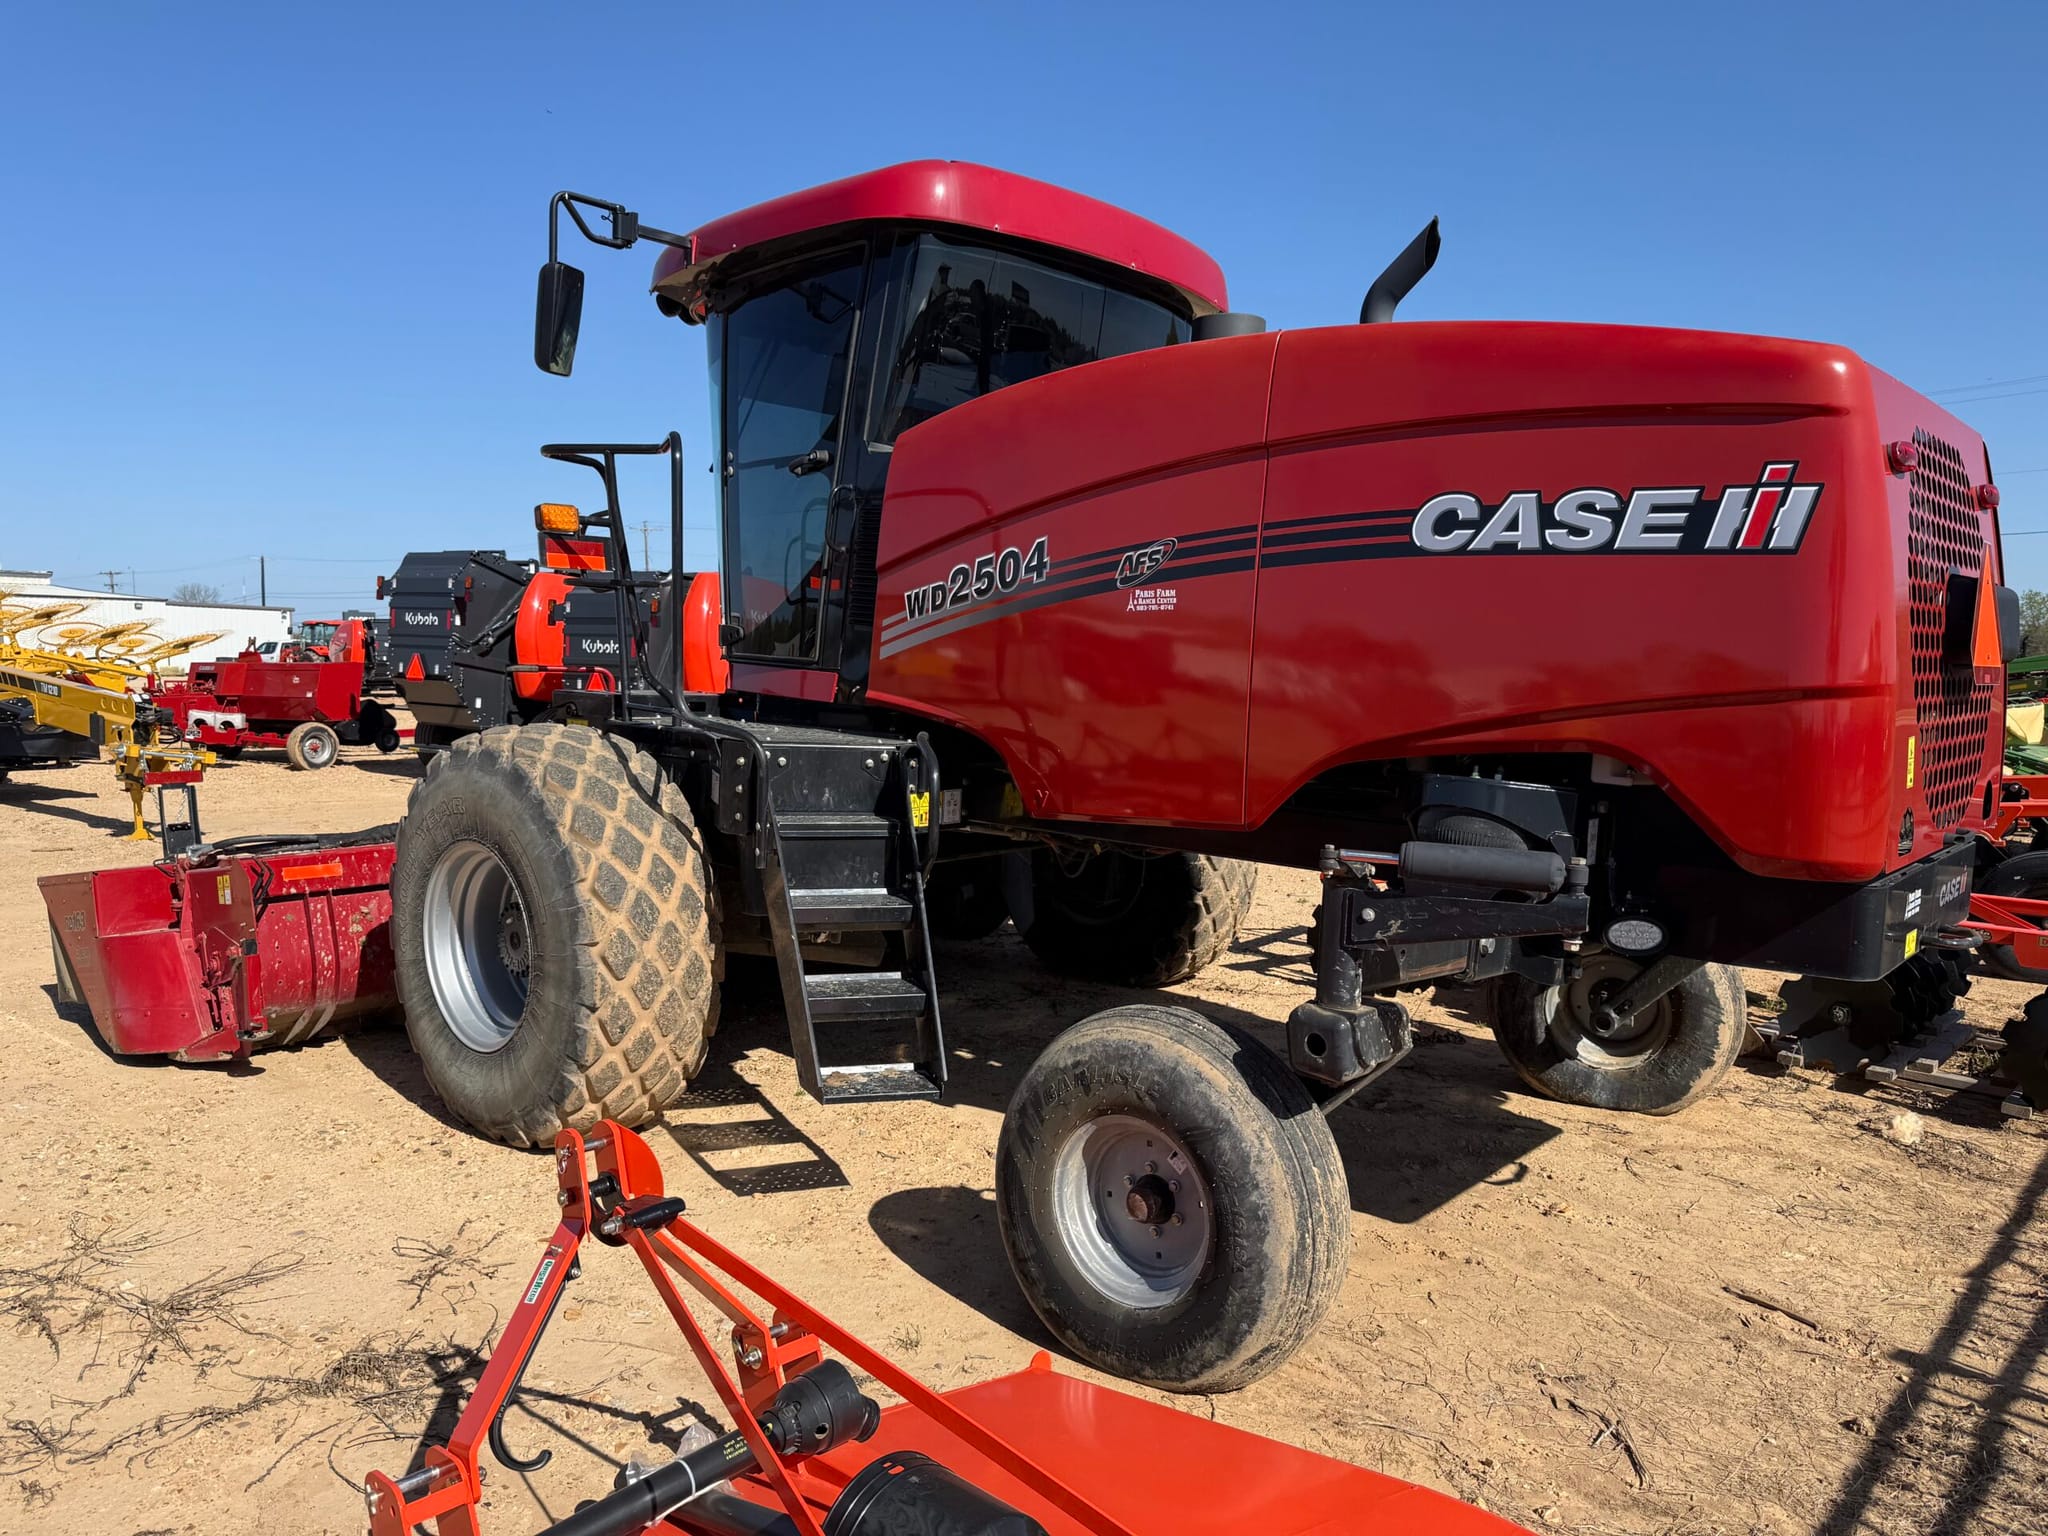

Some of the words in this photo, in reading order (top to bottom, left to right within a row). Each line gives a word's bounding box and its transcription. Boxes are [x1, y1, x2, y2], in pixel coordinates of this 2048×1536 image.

[1412, 488, 1703, 552] CASE
[904, 536, 1049, 621] WD2504
[1115, 546, 1166, 580] AFS
[1156, 588, 1176, 597] FARM
[405, 612, 438, 626] Kubota
[1939, 876, 1960, 908] CASE
